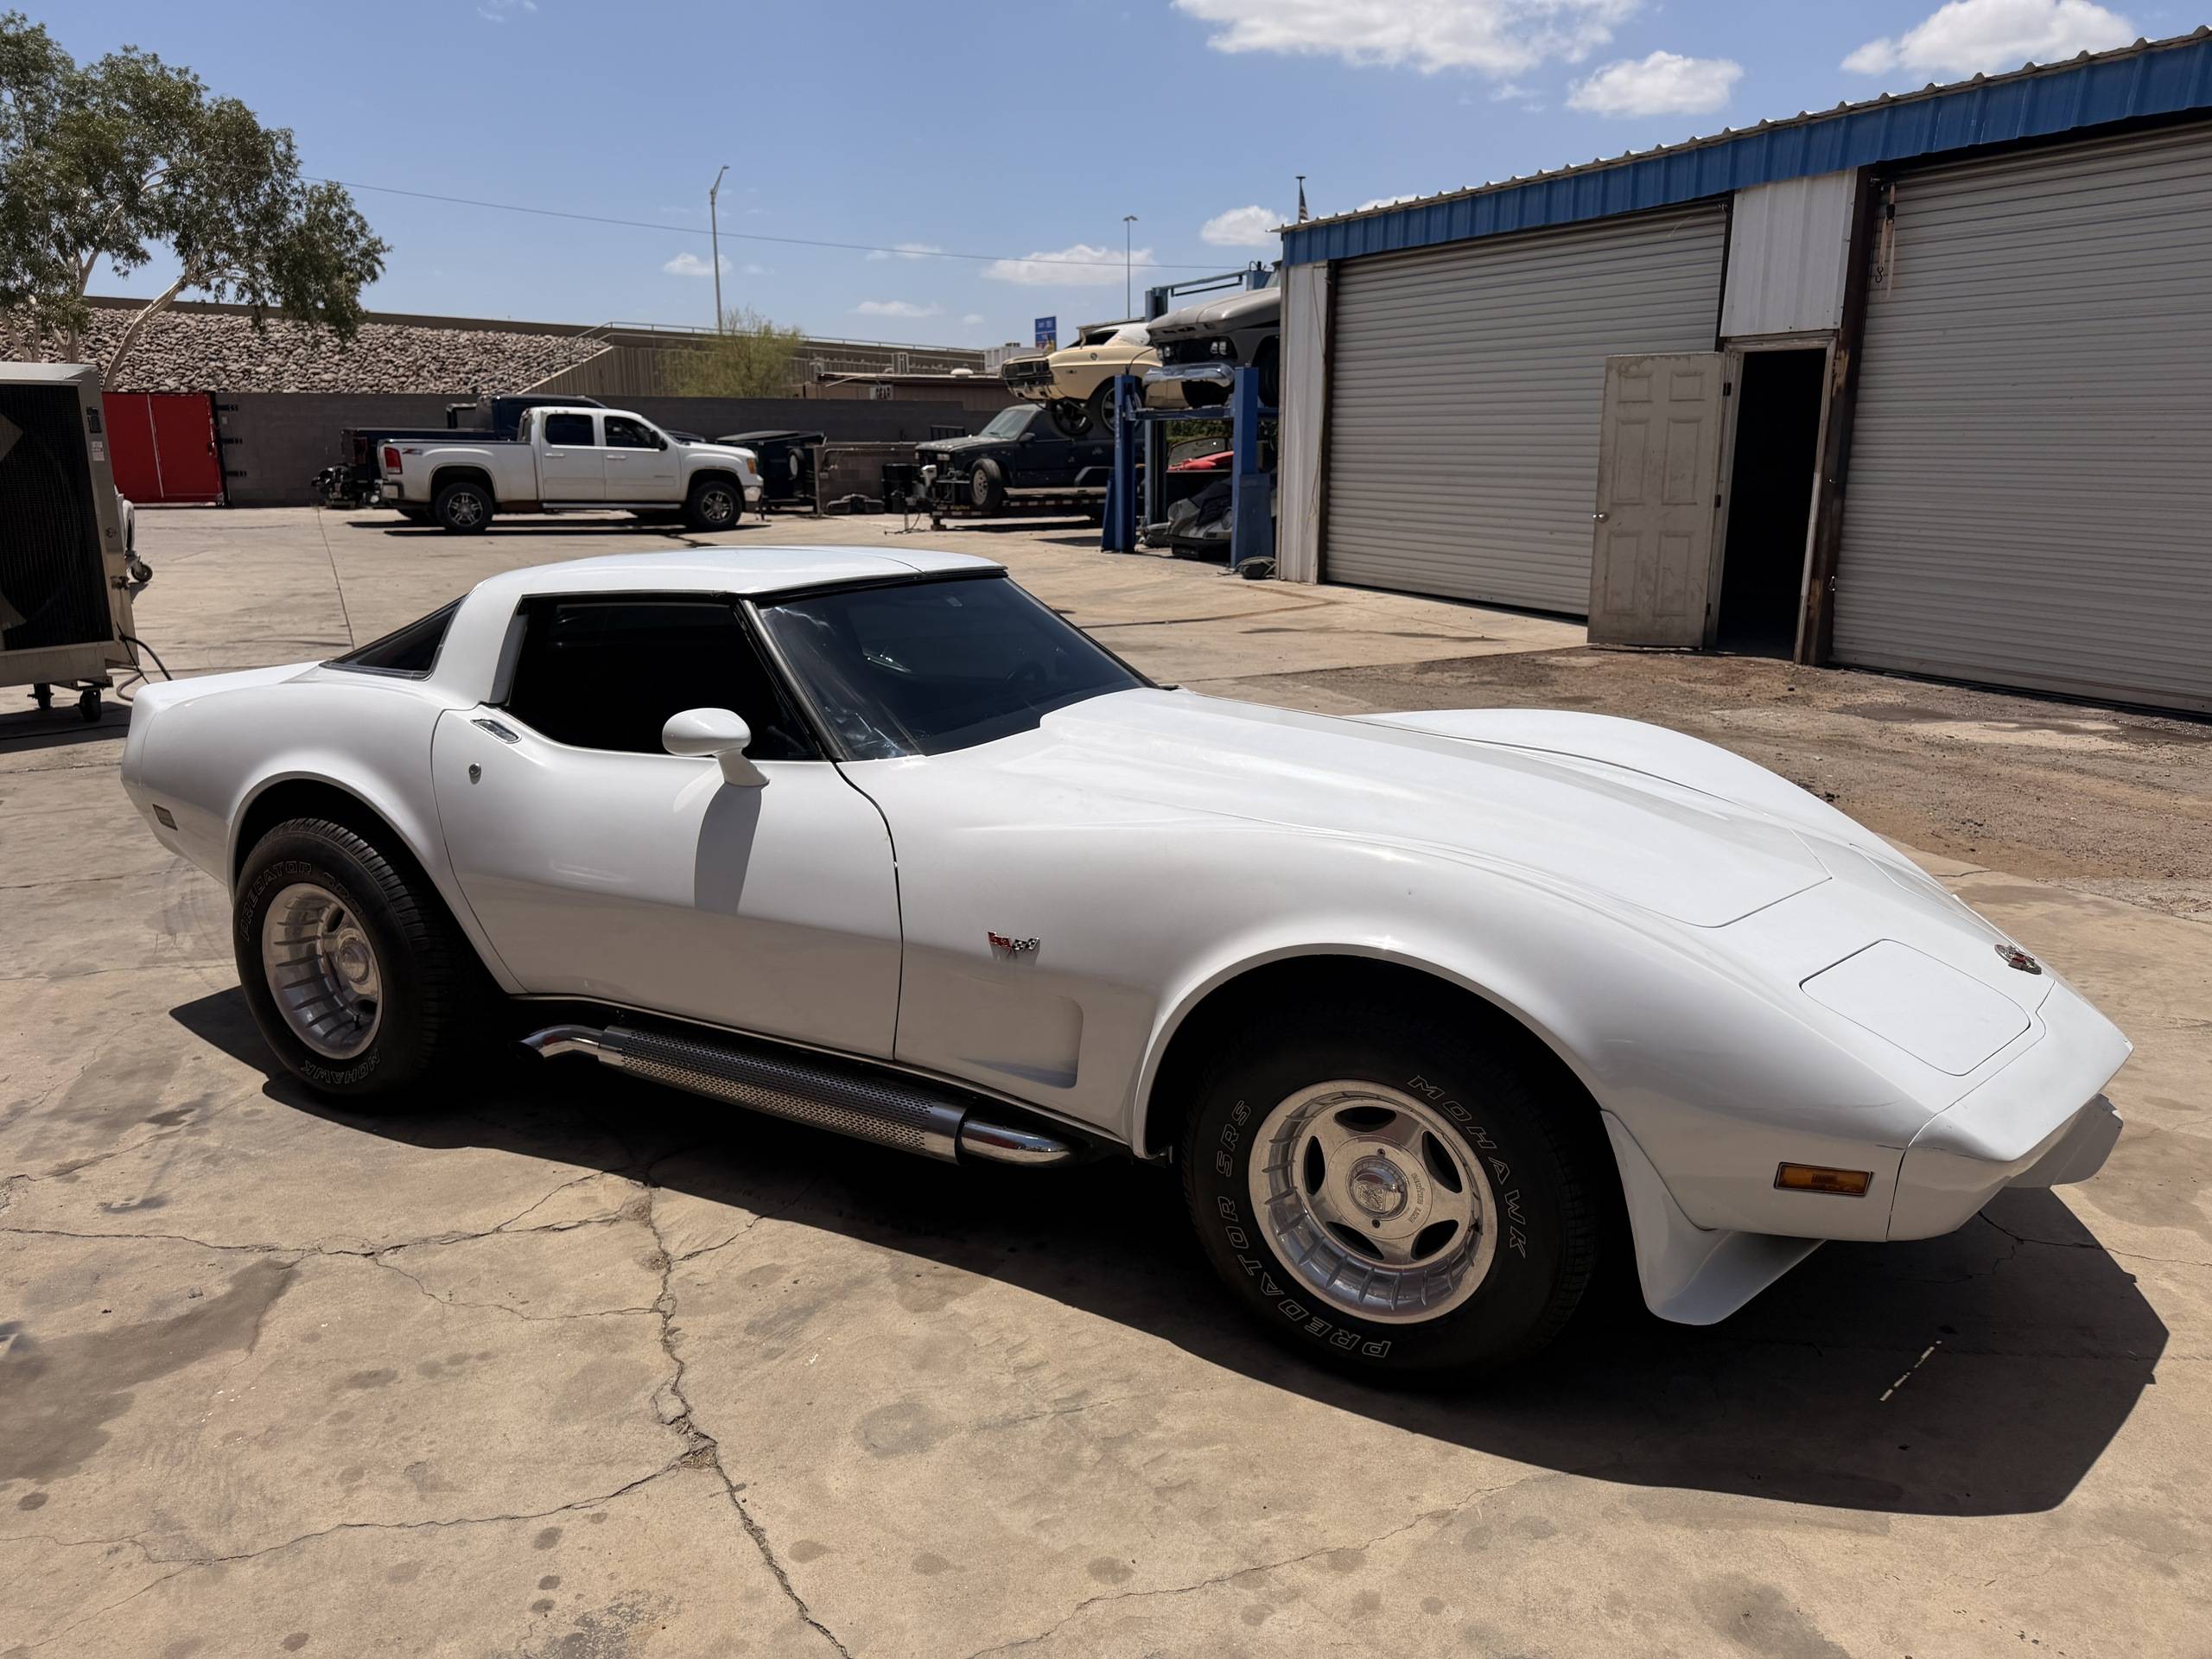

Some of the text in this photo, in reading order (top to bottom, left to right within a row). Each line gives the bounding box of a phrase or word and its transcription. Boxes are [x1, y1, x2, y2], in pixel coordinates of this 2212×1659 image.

[240, 861, 311, 941] PREDATOR
[302, 1049, 380, 1084] MOHAWK
[1216, 1101, 1390, 1357] PREDATOR SRS
[1408, 1076, 1528, 1258] MOHAWK
